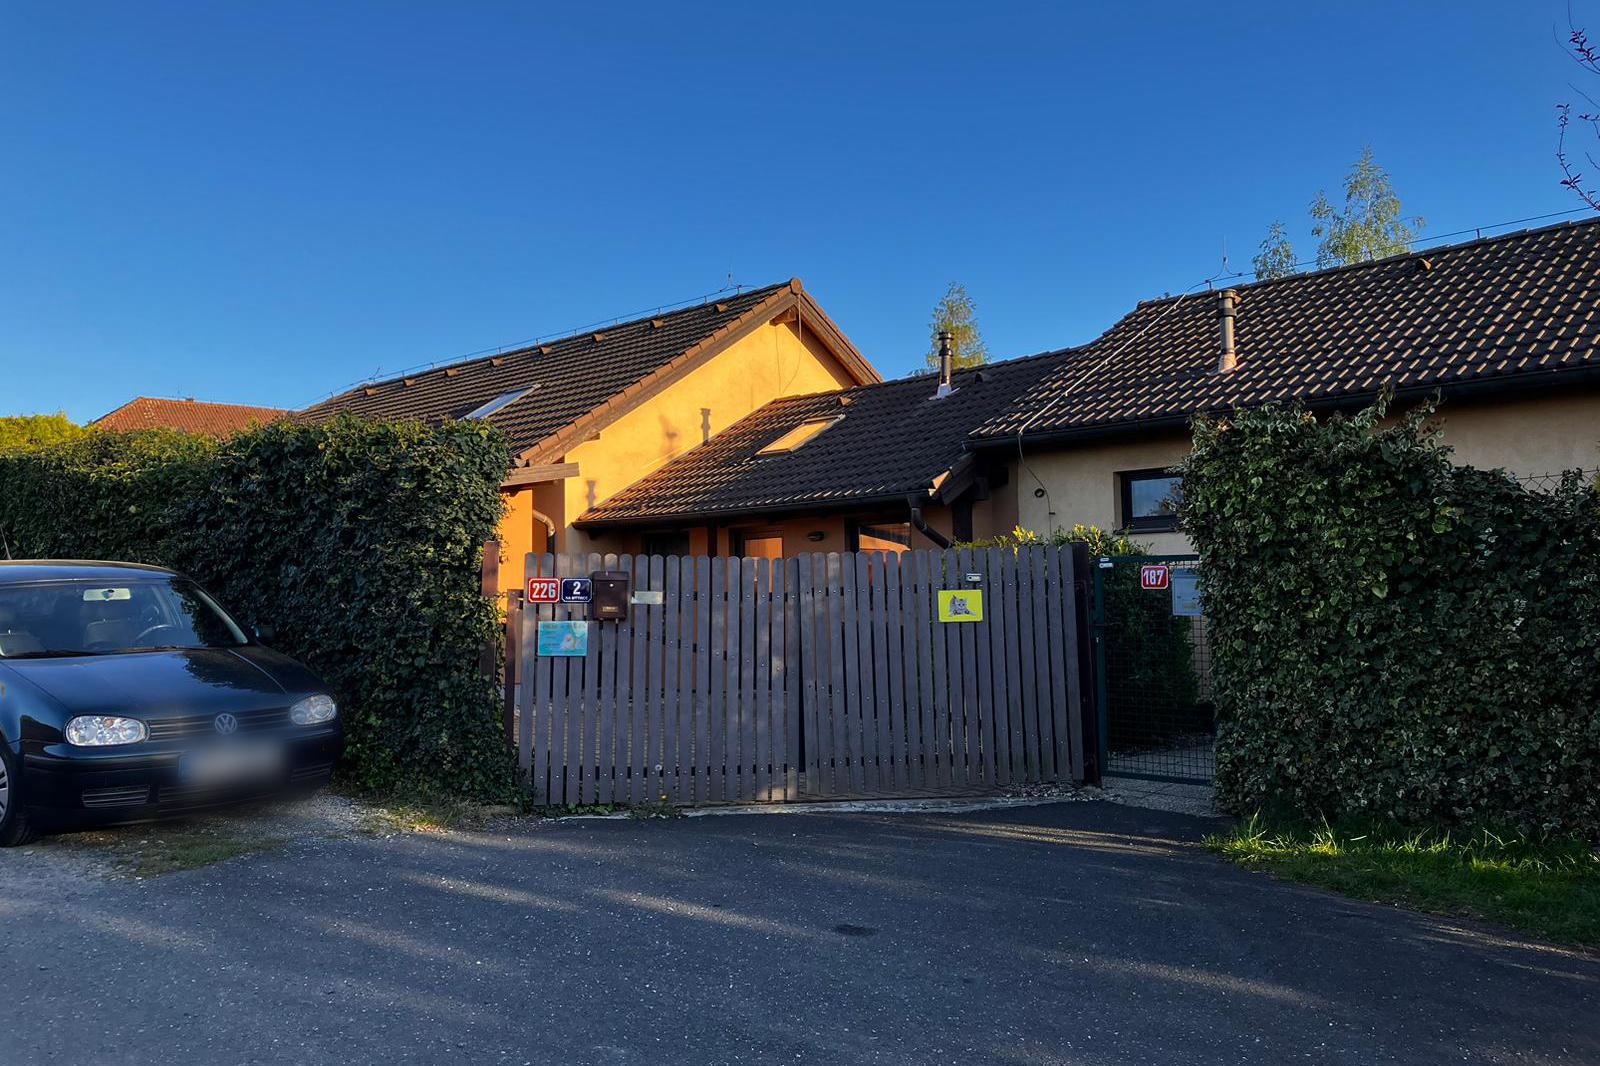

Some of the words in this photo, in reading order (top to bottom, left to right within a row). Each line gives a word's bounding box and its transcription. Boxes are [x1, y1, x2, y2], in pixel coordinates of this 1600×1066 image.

[1143, 570, 1165, 586] 187
[532, 582, 557, 599] 226
[573, 581, 581, 595] 2
